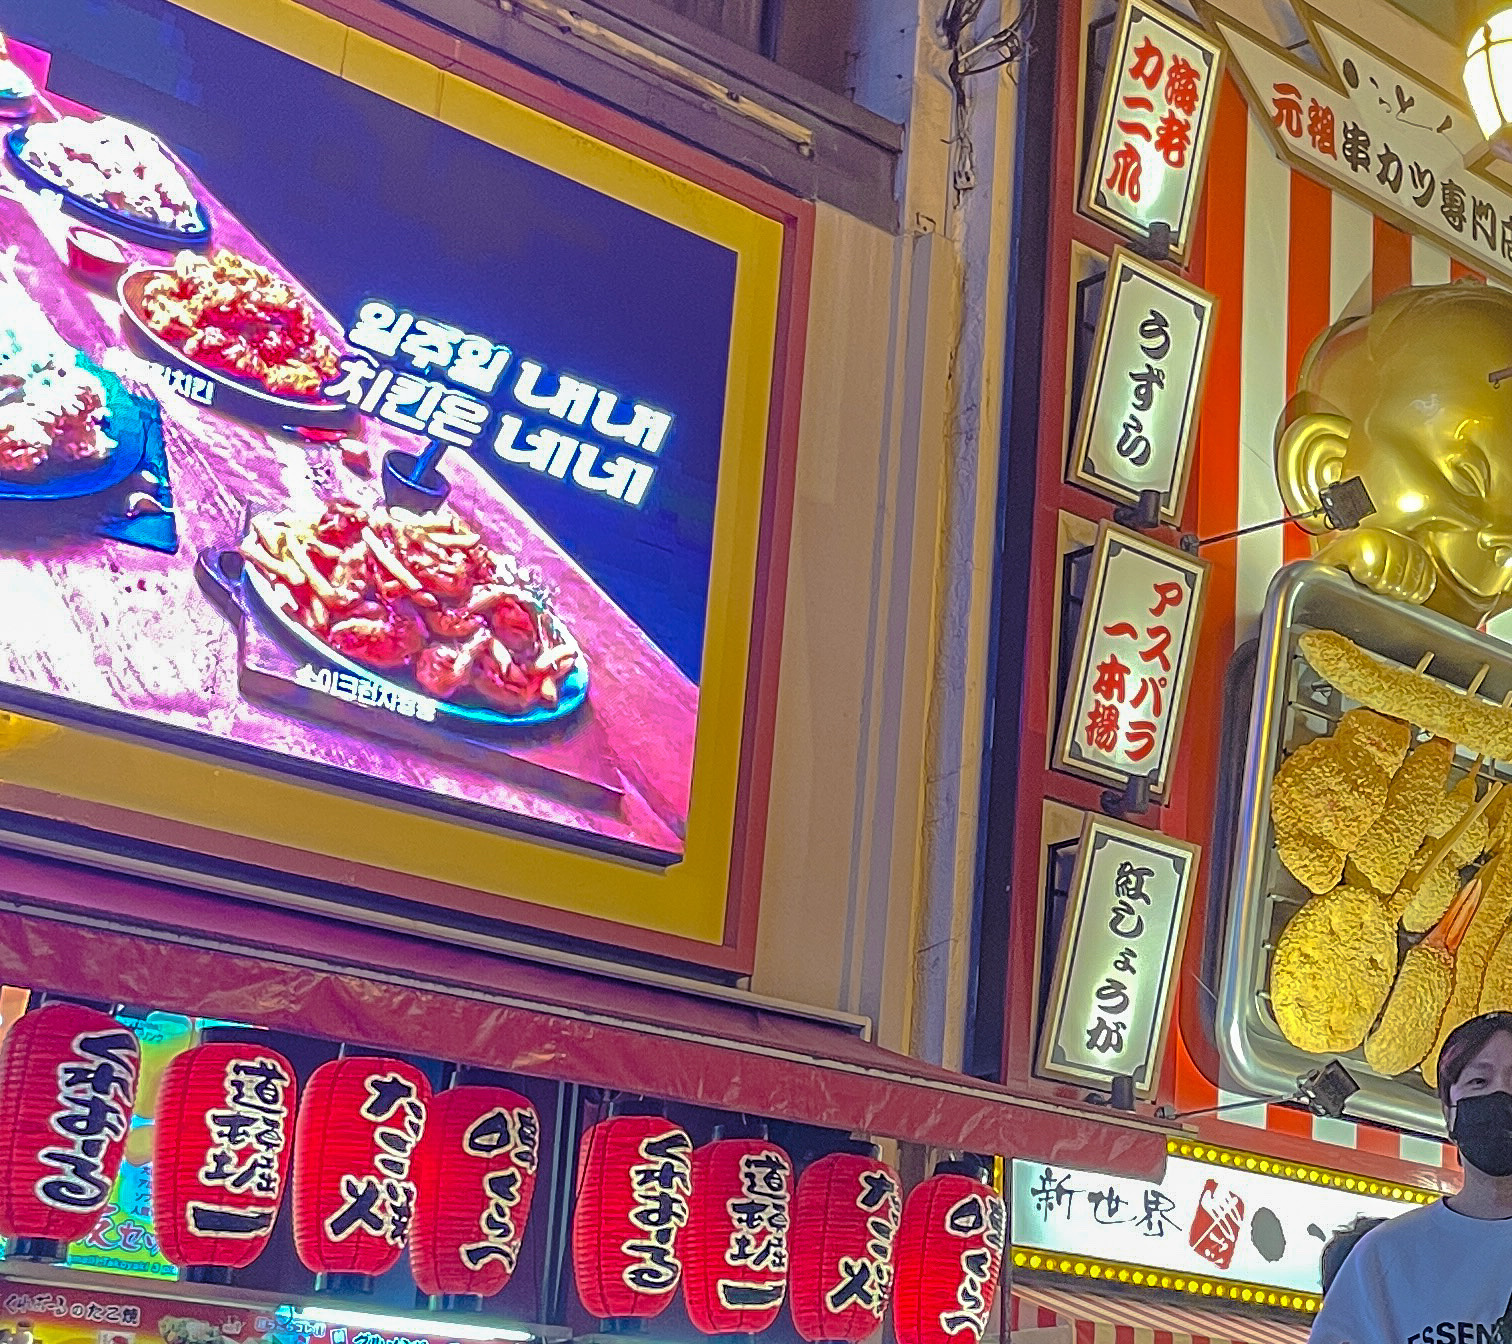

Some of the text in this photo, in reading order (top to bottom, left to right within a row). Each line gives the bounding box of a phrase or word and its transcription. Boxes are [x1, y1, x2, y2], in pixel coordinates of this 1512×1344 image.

[1105, 37, 1163, 203] カニ爪
[1155, 55, 1199, 168] 海老
[325, 358, 655, 506] 치킨은 네네
[349, 301, 673, 453] 일주일 내내
[1116, 308, 1172, 468] うずら
[1085, 620, 1138, 754] 一本揚
[1123, 581, 1184, 762] アスパラ
[1086, 860, 1155, 1055] 紅しょうが
[1030, 1166, 1182, 1238] 新世界
